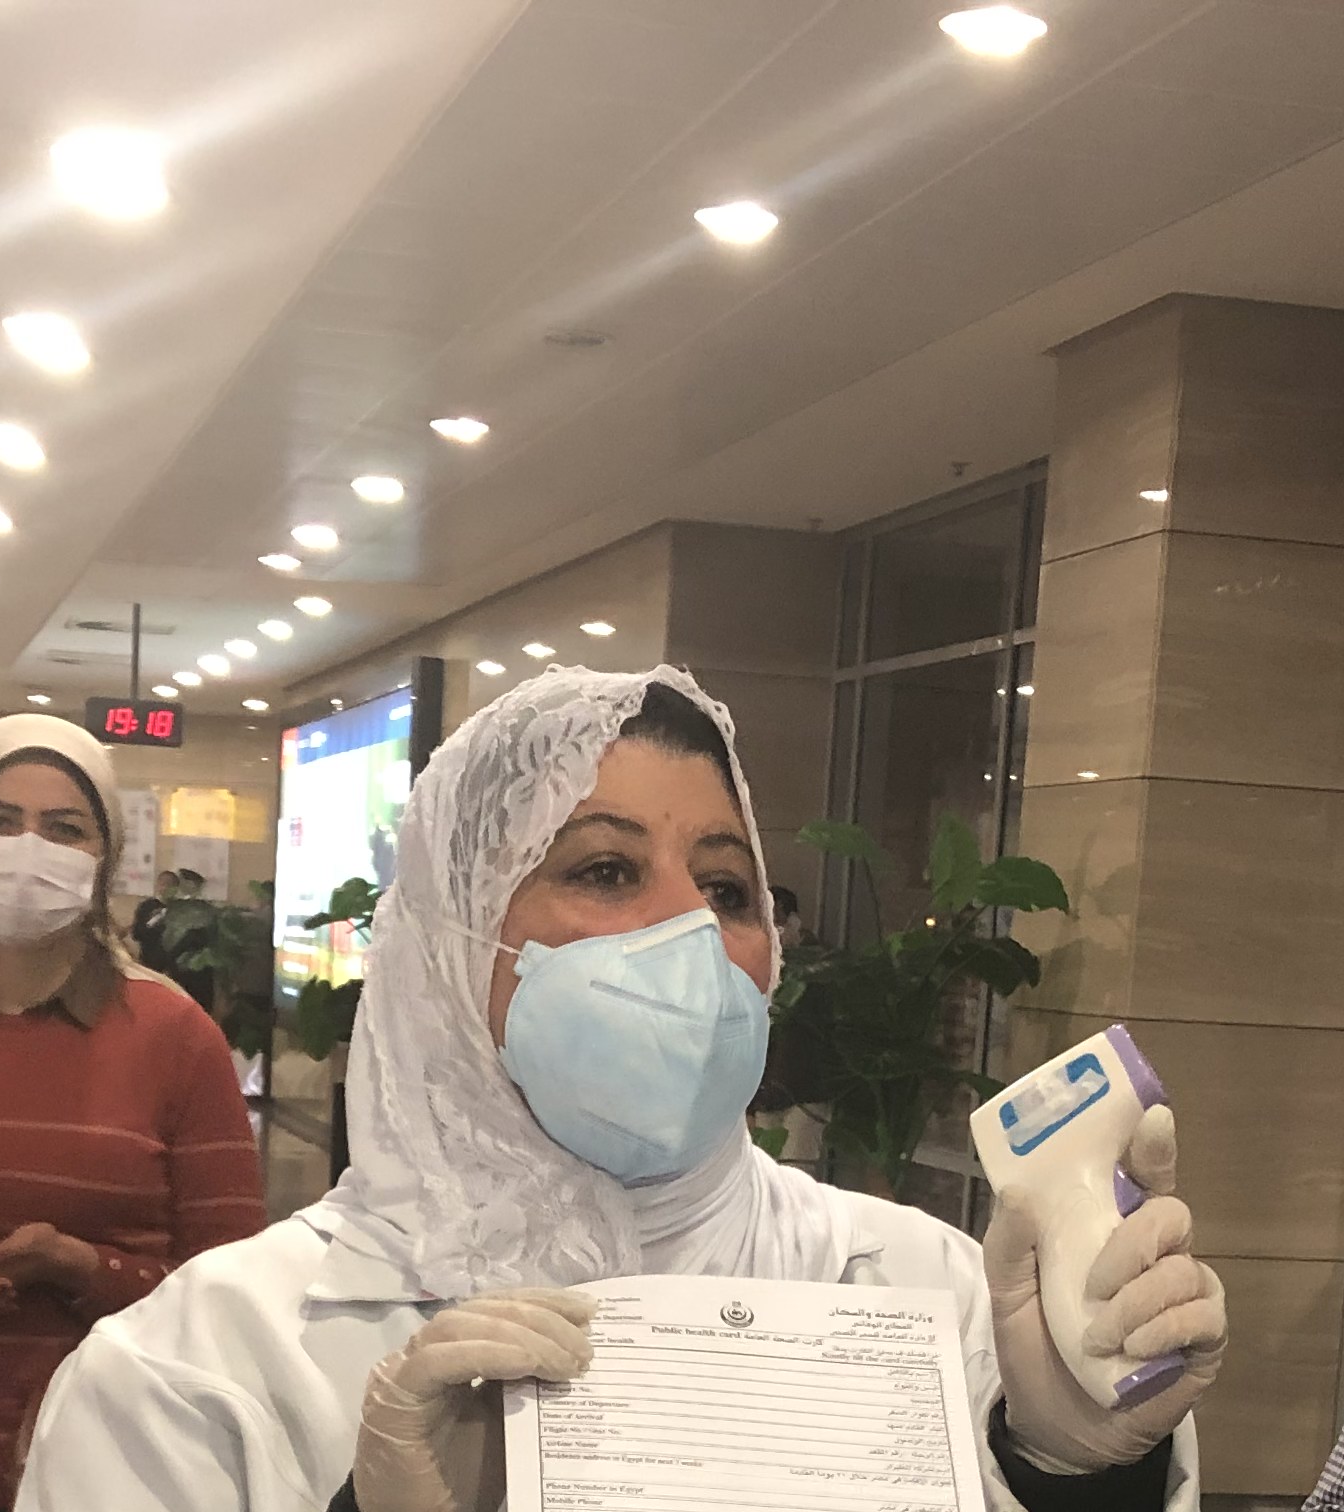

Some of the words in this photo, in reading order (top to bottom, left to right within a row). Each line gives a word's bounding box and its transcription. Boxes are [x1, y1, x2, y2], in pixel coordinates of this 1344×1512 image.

[105, 708, 174, 736] 19:18
[651, 1325, 682, 1335] Public
[685, 1327, 716, 1337] health
[719, 1331, 741, 1339] card
